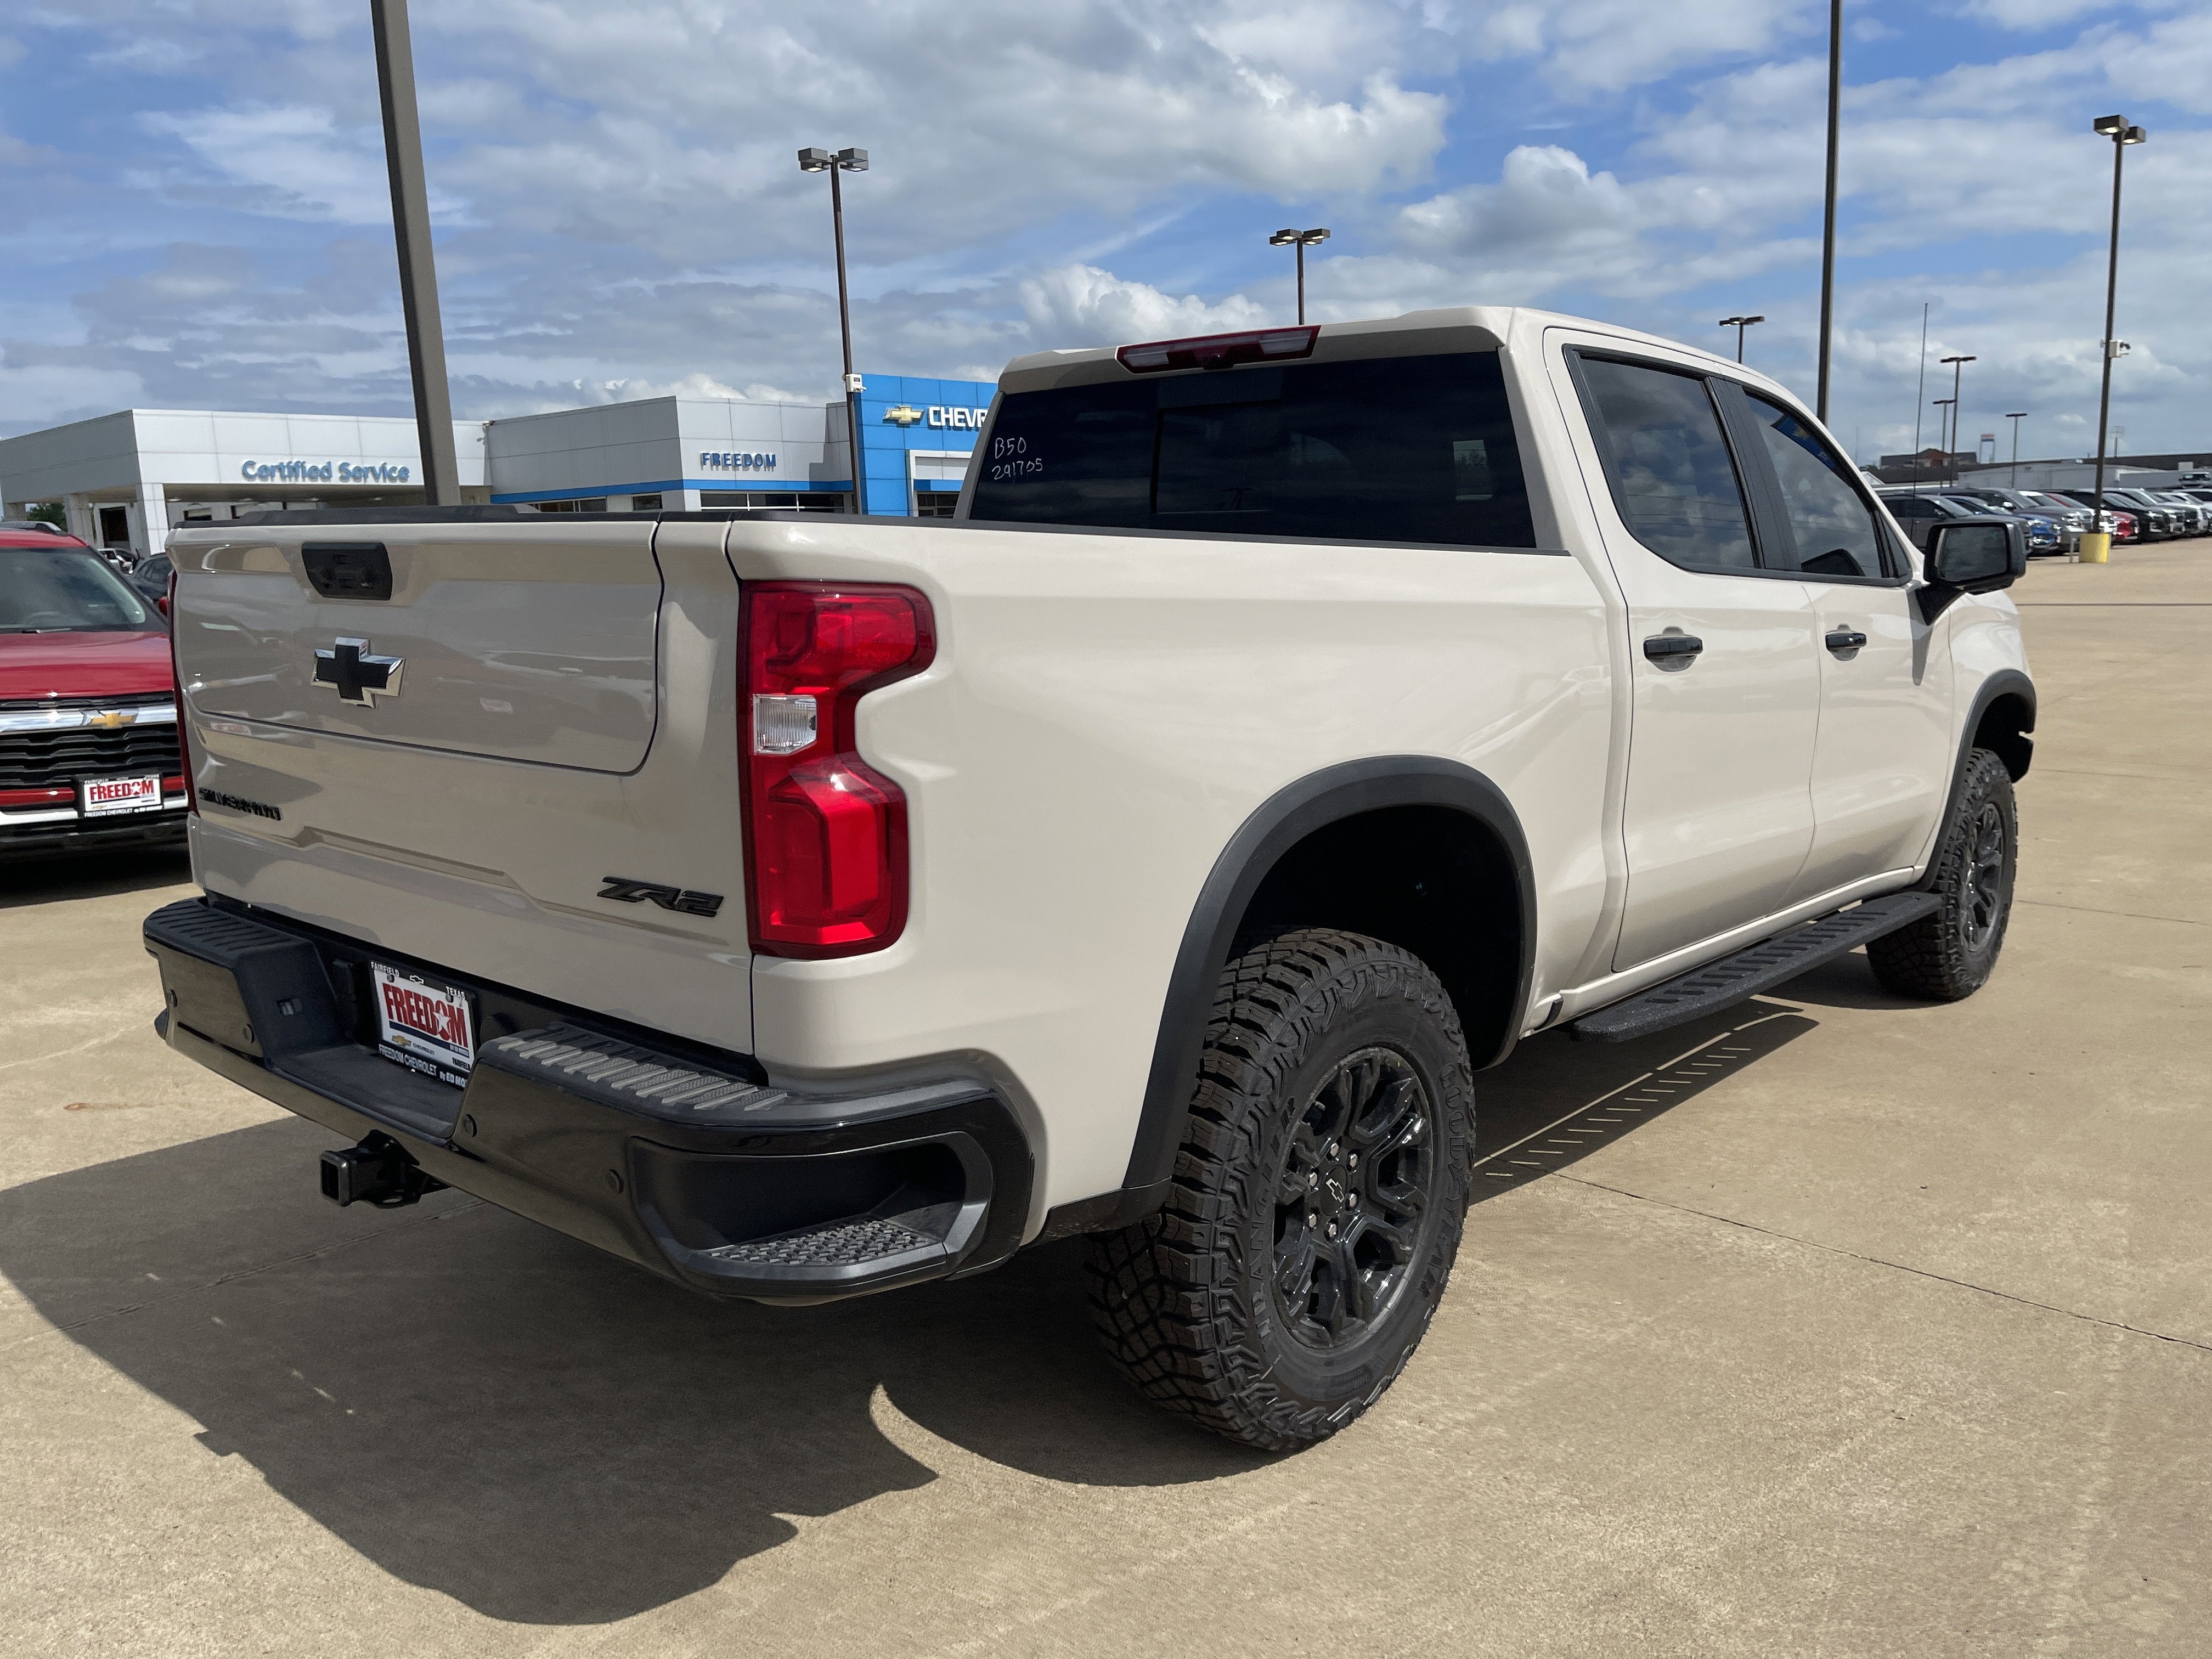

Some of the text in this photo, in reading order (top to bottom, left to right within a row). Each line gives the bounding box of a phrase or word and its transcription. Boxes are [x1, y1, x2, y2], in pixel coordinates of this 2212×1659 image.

[995, 437, 1026, 459] B50
[242, 460, 410, 482] Certified Service
[701, 453, 776, 467] FREEDOM
[991, 458, 1043, 480] 291705
[89, 780, 154, 801] FREEDOM
[597, 876, 724, 918] ZR2
[370, 961, 466, 1000] FAIRFIELD TEXAS
[382, 983, 469, 1048] FREEDOM
[455, 1075, 467, 1088] MO
